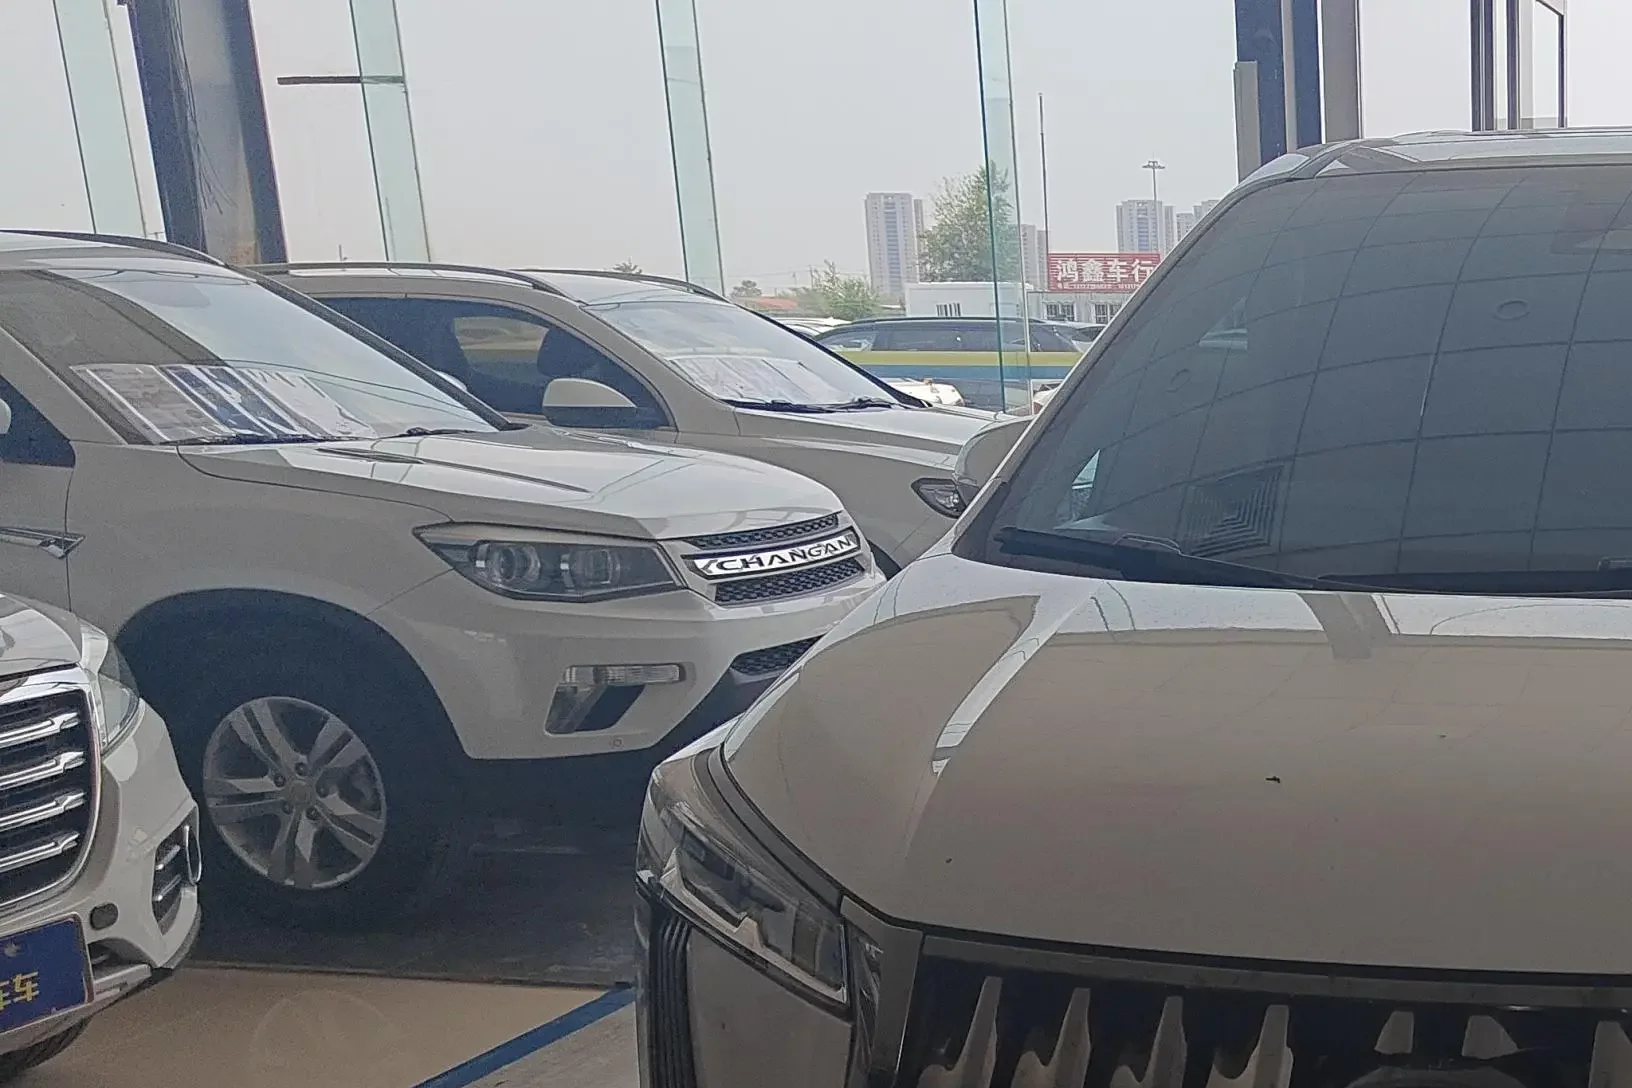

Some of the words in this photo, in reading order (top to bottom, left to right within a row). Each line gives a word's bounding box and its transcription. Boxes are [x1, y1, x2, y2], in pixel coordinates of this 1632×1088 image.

[1056, 259, 1154, 282] 鸿鑫车行
[715, 537, 852, 572] CHANGAN
